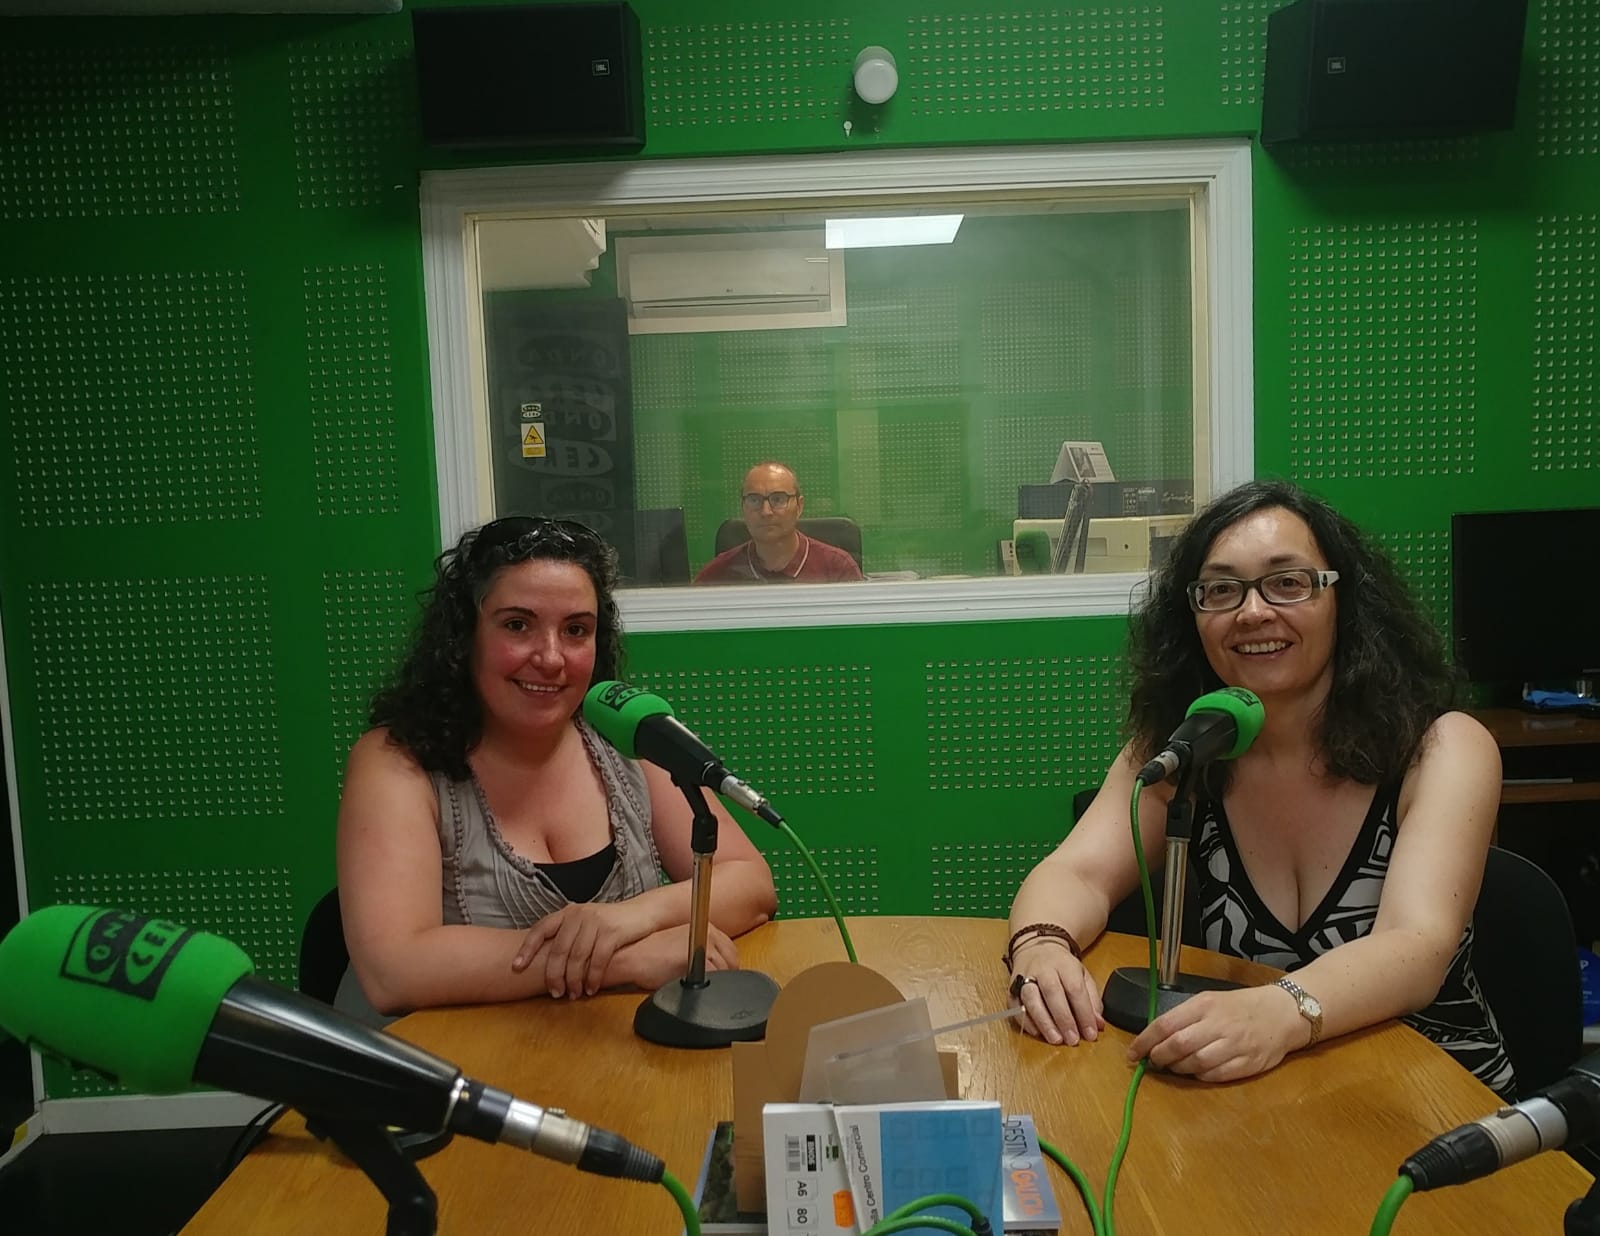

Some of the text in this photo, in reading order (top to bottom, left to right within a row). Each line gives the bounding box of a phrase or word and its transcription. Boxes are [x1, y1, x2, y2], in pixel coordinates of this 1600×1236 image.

[89, 913, 136, 961] OND
[132, 918, 176, 966] CER
[849, 1124, 868, 1173] Comercial
[1003, 1120, 1032, 1169] DESTINO
[797, 1181, 807, 1197] A6
[863, 1175, 876, 1207] Centro
[797, 1208, 807, 1224] 80
